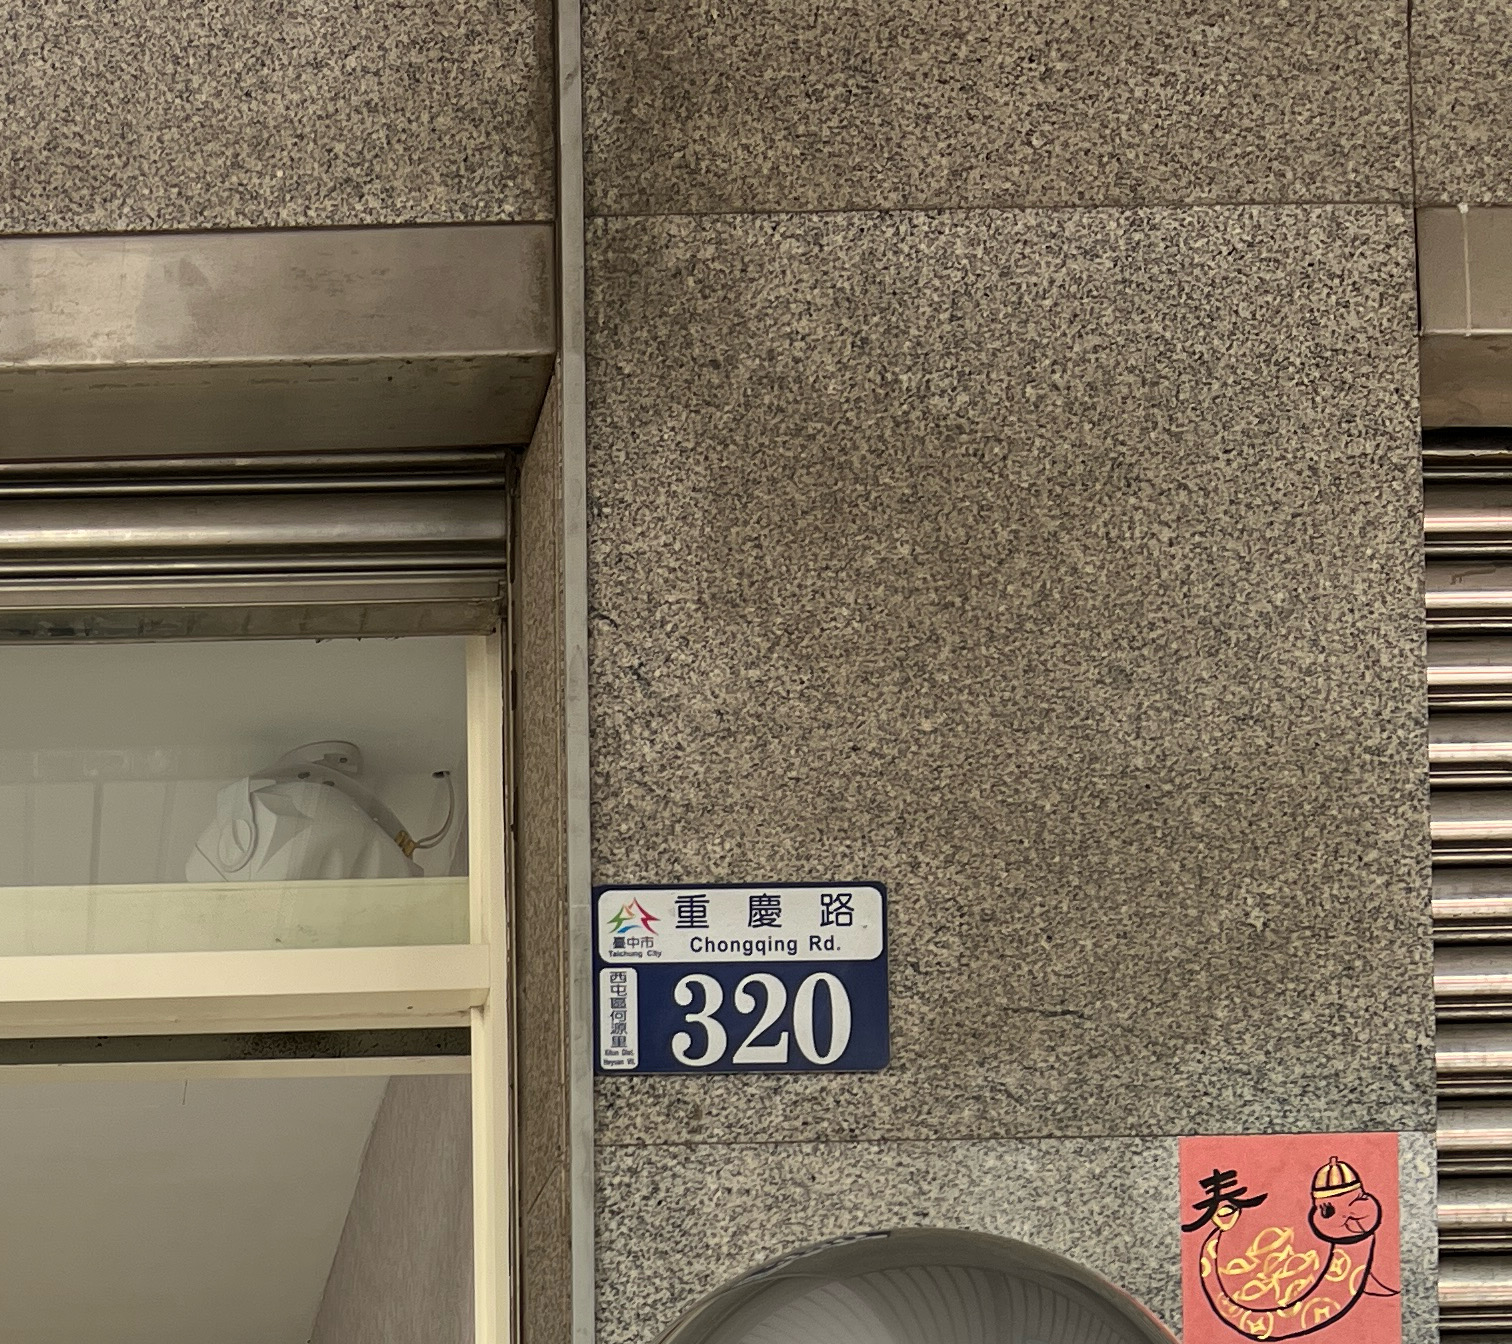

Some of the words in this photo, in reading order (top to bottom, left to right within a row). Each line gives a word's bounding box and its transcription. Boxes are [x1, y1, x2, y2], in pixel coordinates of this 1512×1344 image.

[674, 893, 855, 929] 重慶路
[612, 936, 654, 949] 臺中市
[690, 936, 797, 956] Chongqing
[809, 935, 841, 951] Rd.
[608, 950, 643, 958] Taichung
[646, 950, 662, 958] City
[671, 972, 852, 1067] 320
